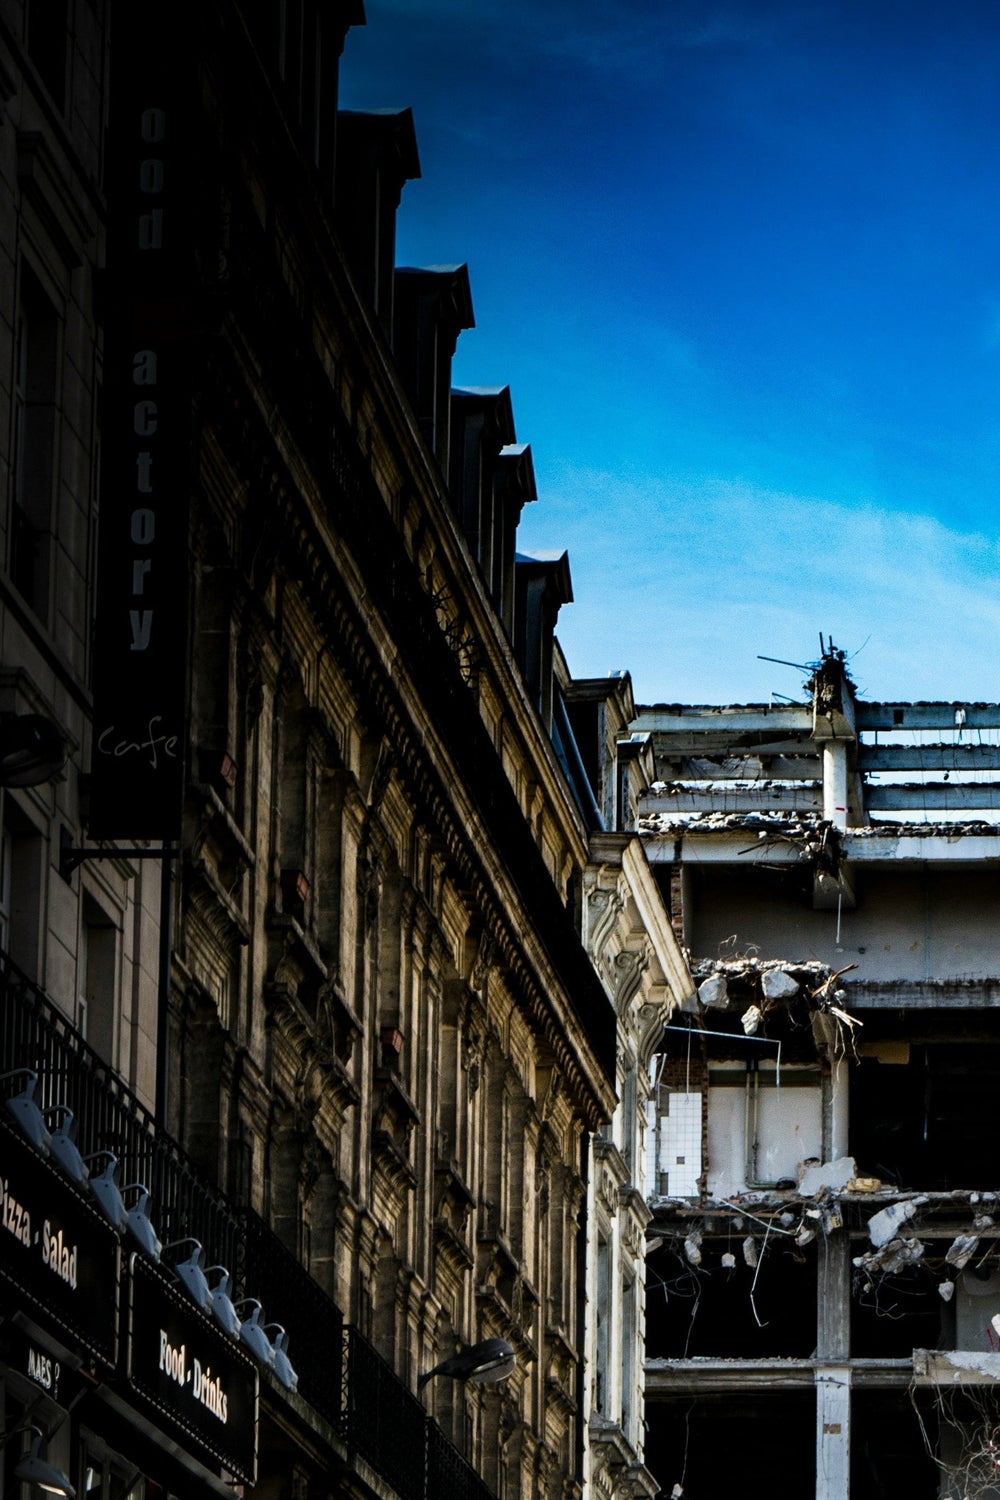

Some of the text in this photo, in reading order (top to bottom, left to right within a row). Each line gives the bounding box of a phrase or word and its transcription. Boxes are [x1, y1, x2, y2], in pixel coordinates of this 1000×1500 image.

[134, 103, 167, 251] ood
[128, 305, 161, 651] actory
[41, 1218, 78, 1291] Salad
[27, 1346, 52, 1390] MAES
[158, 1327, 228, 1425] Food Drinks
